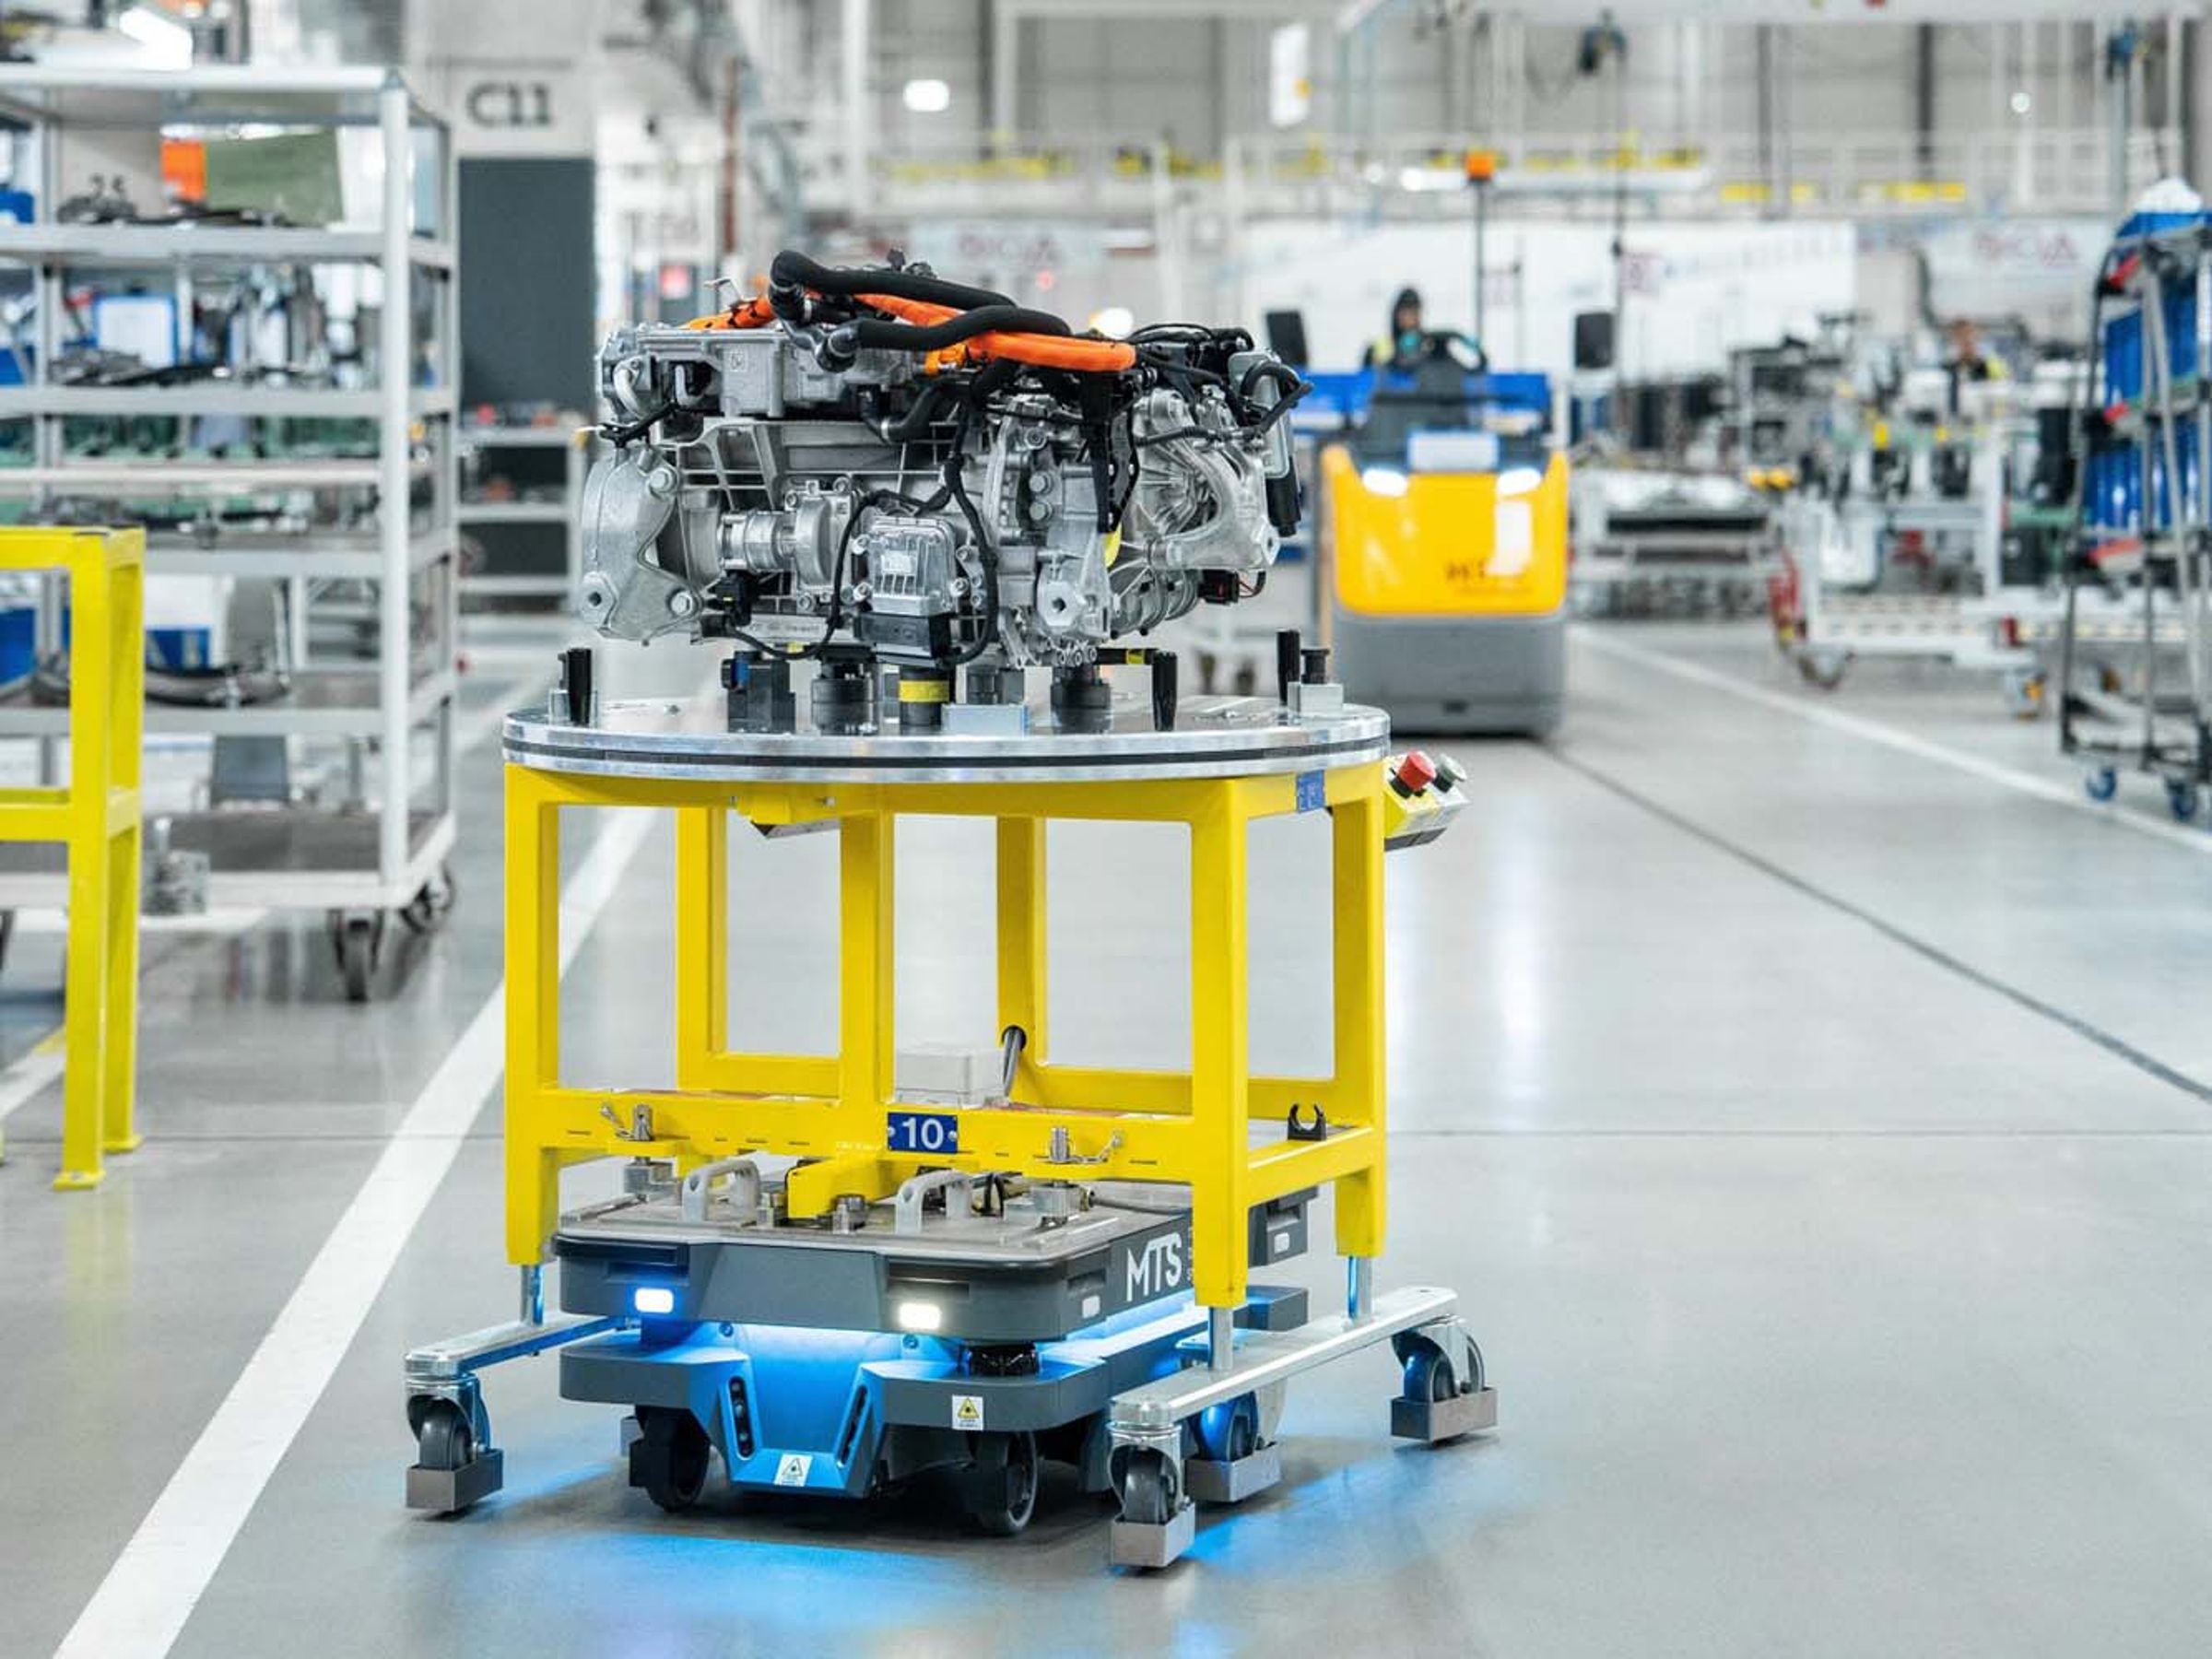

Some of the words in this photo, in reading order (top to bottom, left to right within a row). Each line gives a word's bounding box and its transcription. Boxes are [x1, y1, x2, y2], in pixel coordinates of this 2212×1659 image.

[465, 81, 550, 128] C11
[902, 1117, 943, 1150] 10
[1126, 1232, 1182, 1301] MTS
